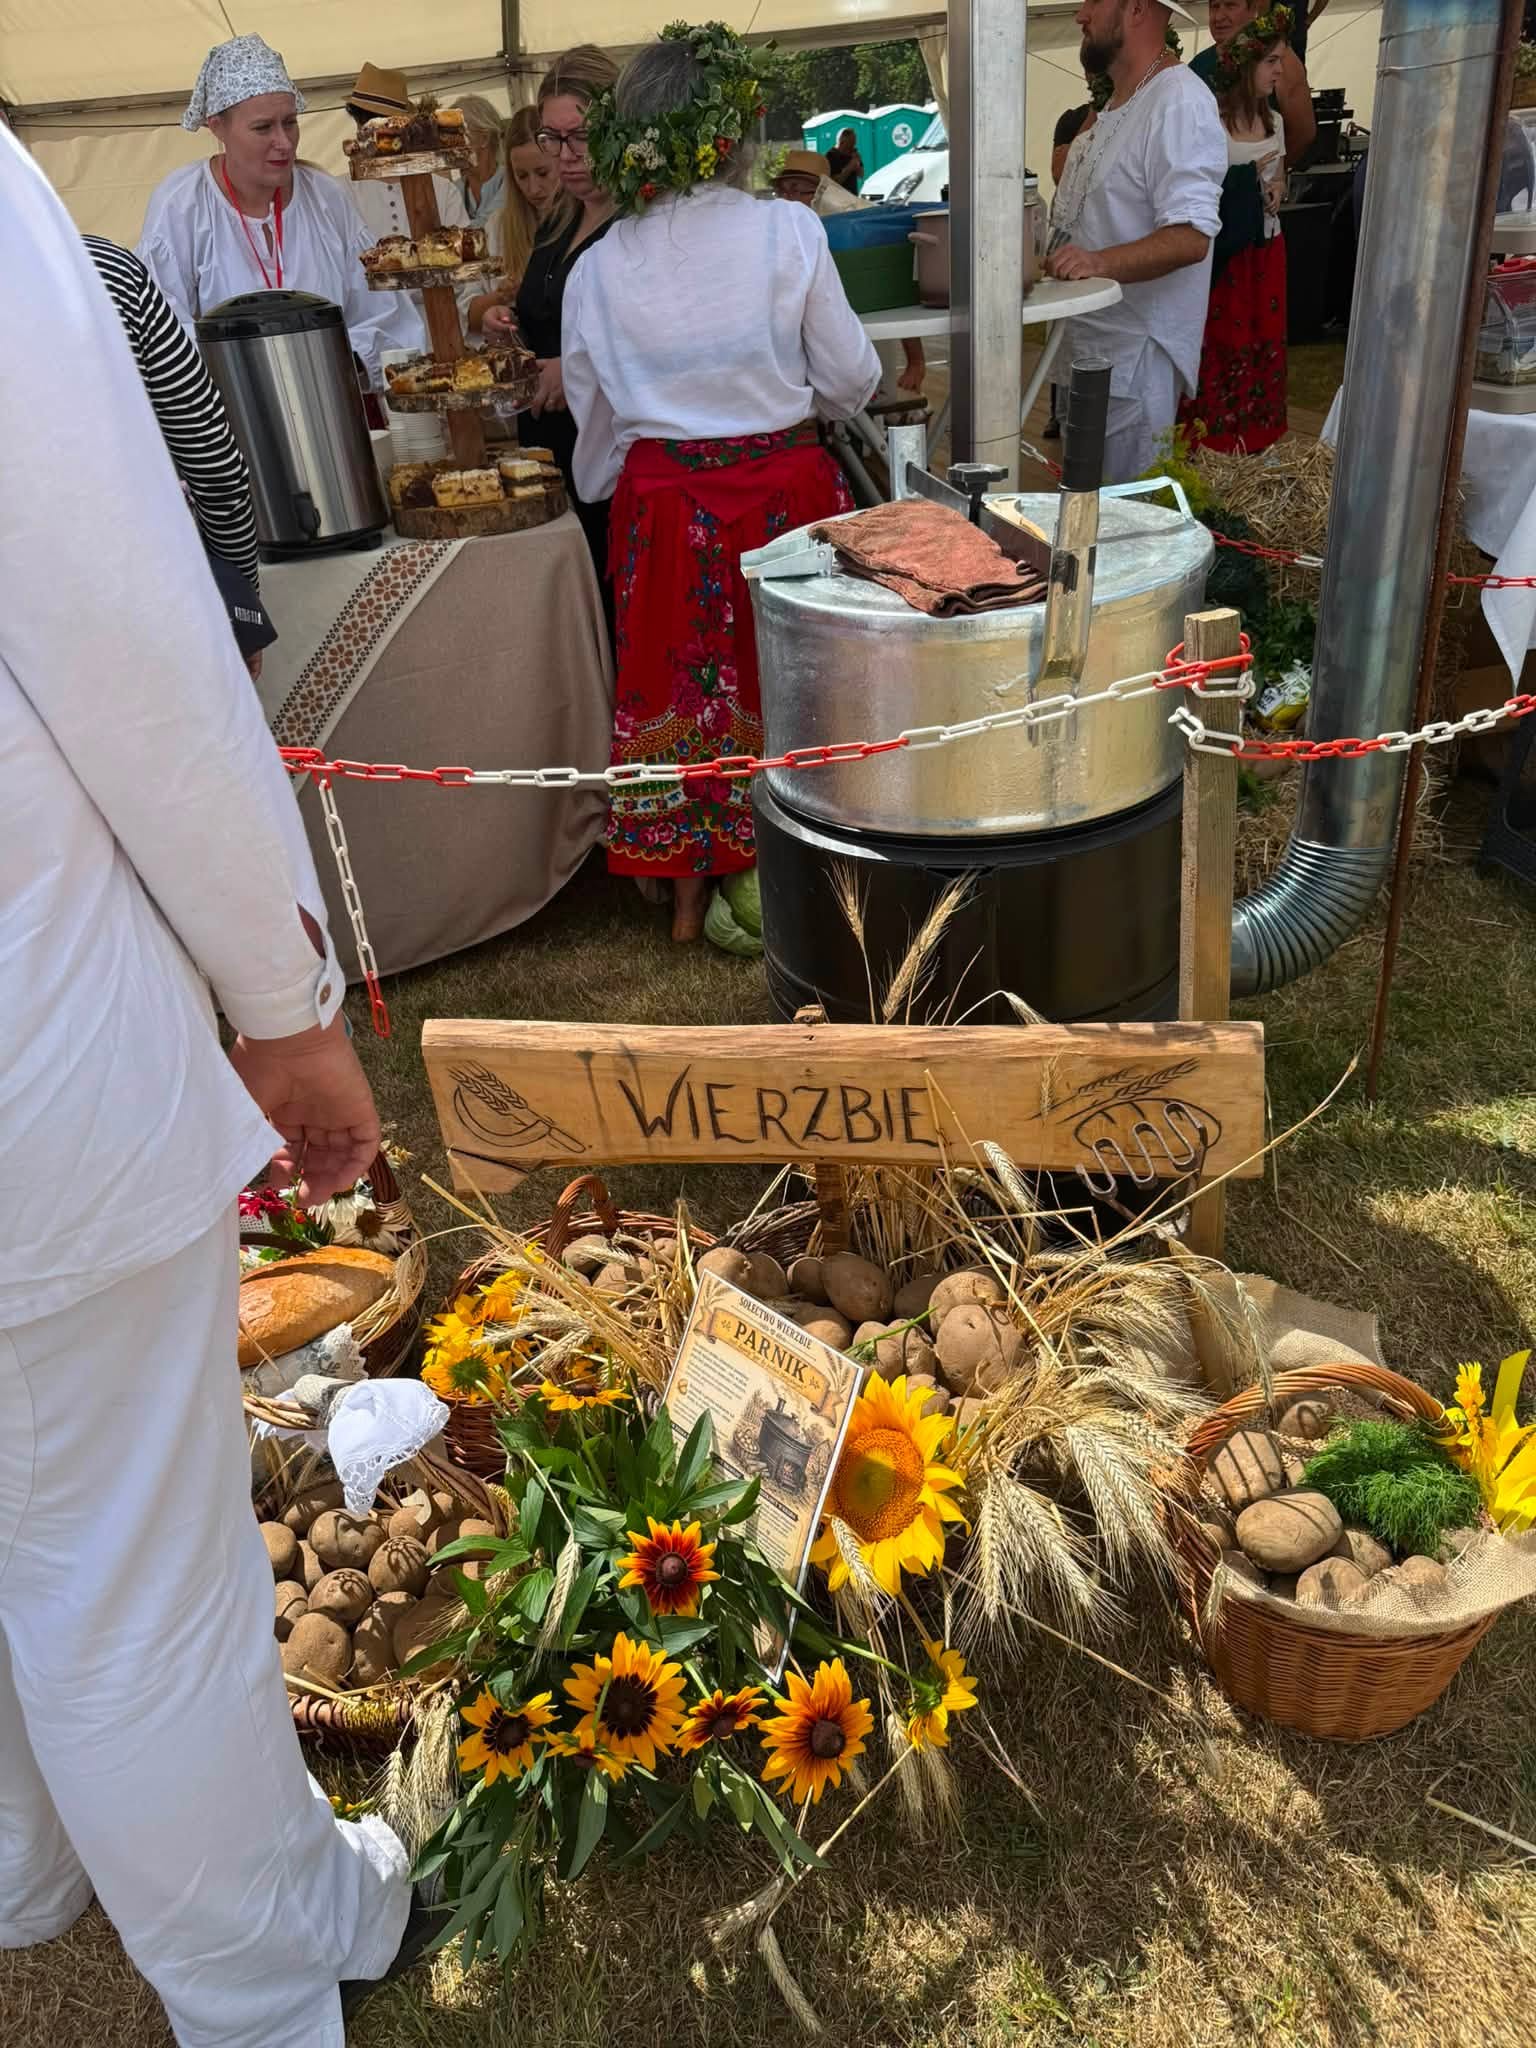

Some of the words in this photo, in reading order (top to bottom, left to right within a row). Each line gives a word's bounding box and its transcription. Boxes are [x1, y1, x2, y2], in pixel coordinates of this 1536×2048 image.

[618, 1064, 940, 1150] WIERZBIE
[734, 1321, 808, 1383] PARNIK
[776, 1319, 813, 1350] WIERZBIE
